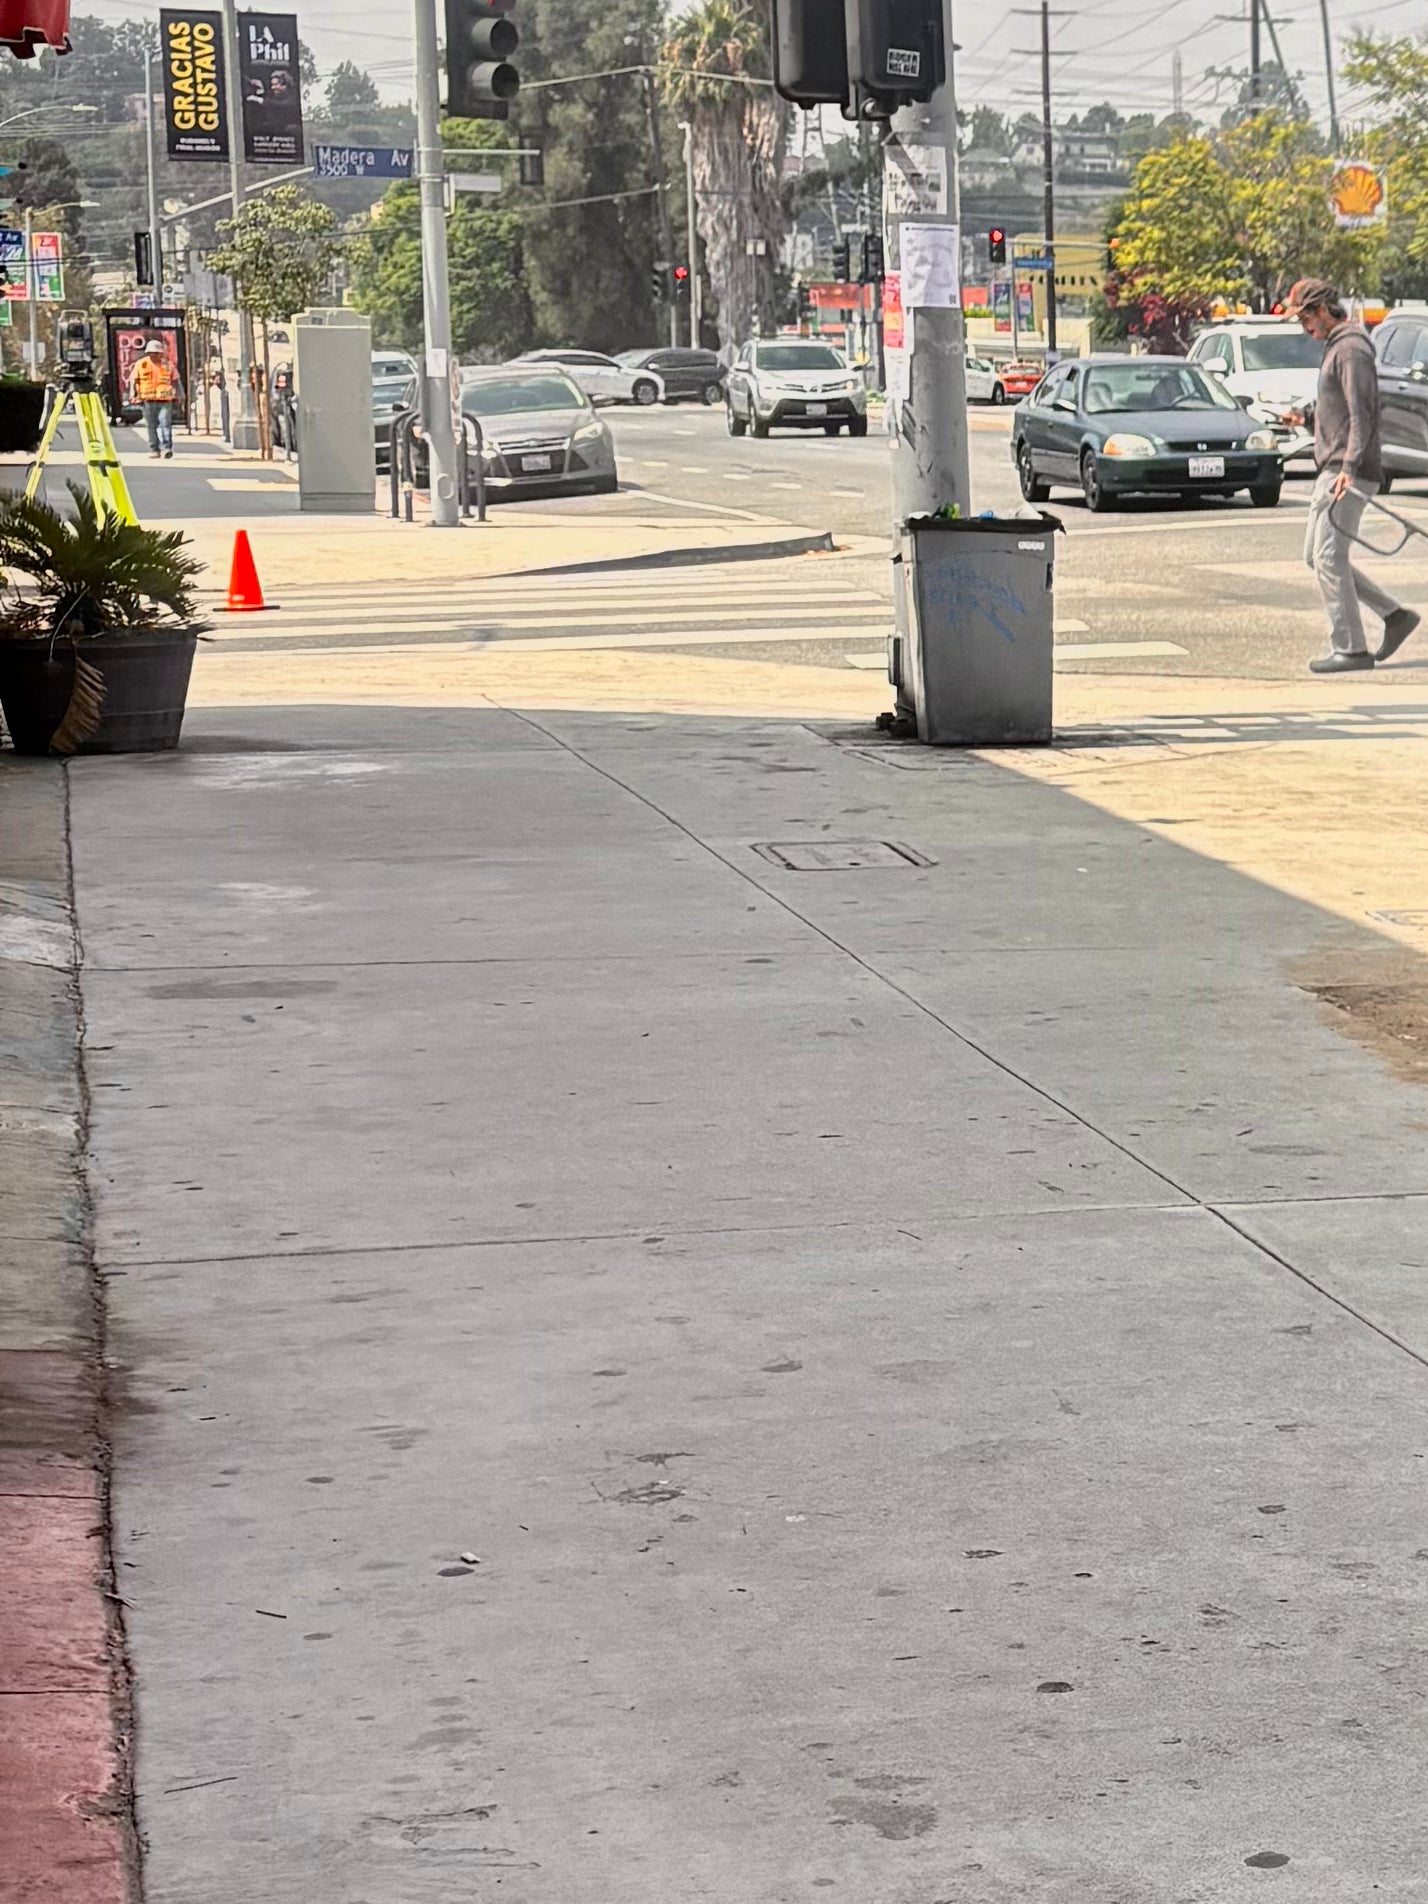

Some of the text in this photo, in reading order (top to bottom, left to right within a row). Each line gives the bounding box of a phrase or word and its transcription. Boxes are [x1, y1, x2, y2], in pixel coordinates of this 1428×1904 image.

[249, 24, 274, 43] LA
[249, 42, 290, 61] Phil
[168, 20, 196, 130] GRACIAS
[192, 22, 220, 131] GUSTAVO
[318, 147, 410, 167] Madera Av
[118, 335, 146, 349] DO
